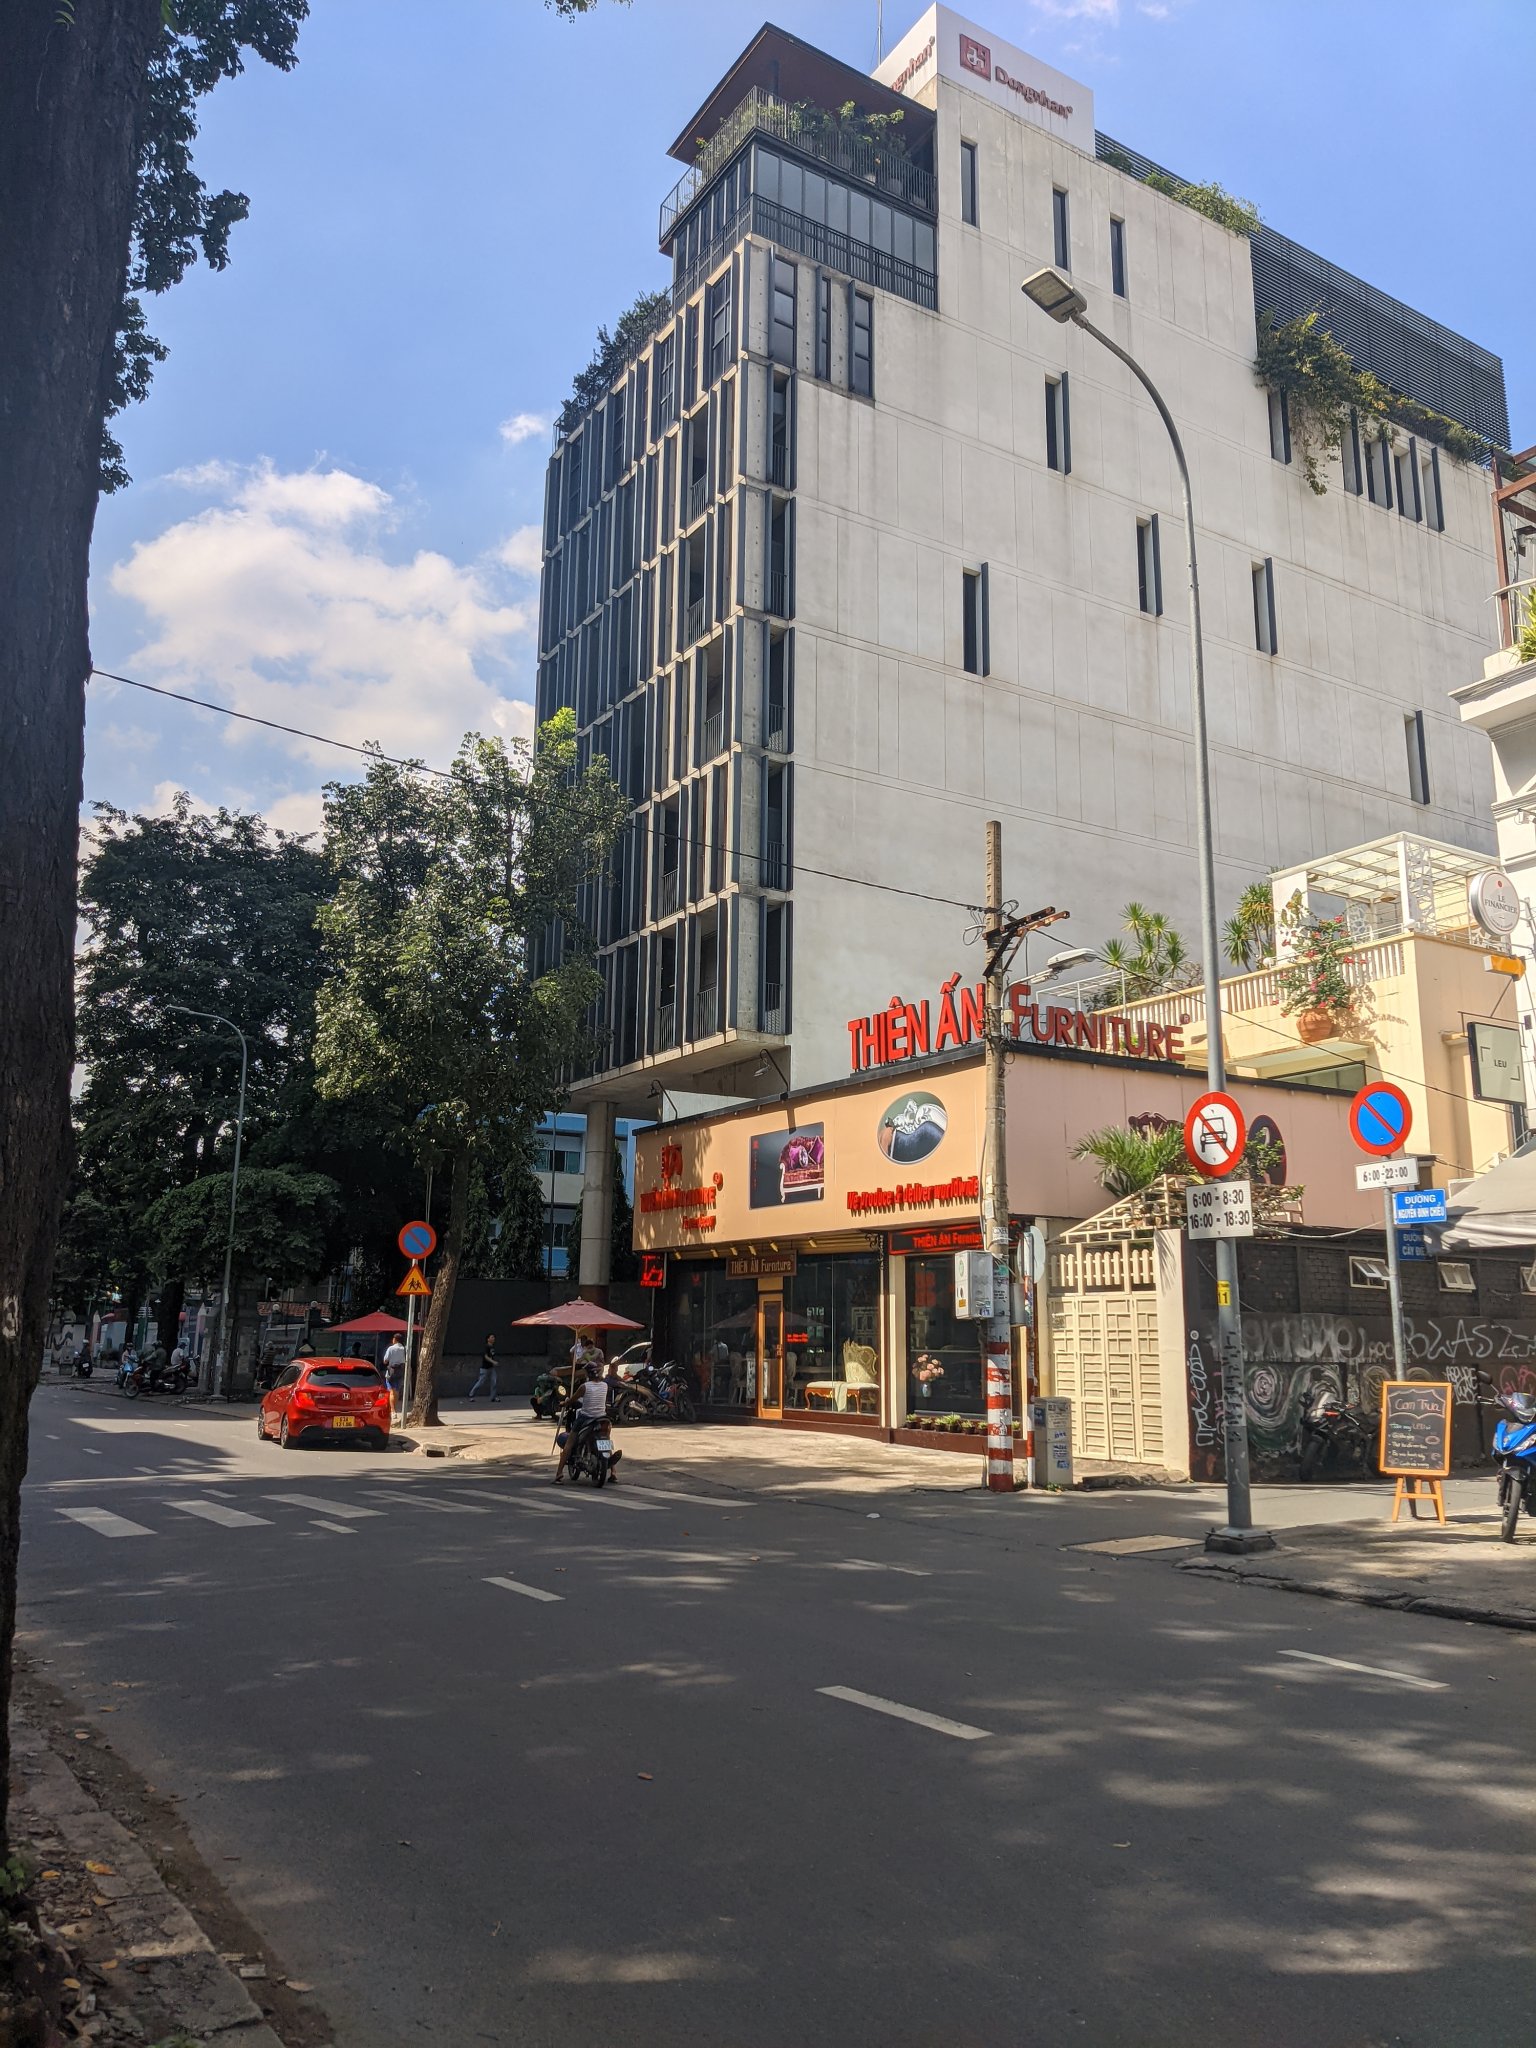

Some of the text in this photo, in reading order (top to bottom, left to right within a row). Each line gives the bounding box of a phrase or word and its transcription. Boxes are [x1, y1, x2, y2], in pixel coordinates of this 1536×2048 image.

[847, 971, 1186, 1070] THIÊN ẤN FURNITURE
[1494, 1059, 1507, 1068] LEU
[1192, 1192, 1212, 1208] 6:00
[1223, 1189, 1244, 1205] 8:30
[1404, 1194, 1436, 1205] ĐƯỜNG
[1189, 1213, 1213, 1229] 16:00
[1224, 1210, 1250, 1226] 18:30
[1403, 1231, 1423, 1242] ĐƯỜ
[761, 1258, 791, 1273] Furniture
